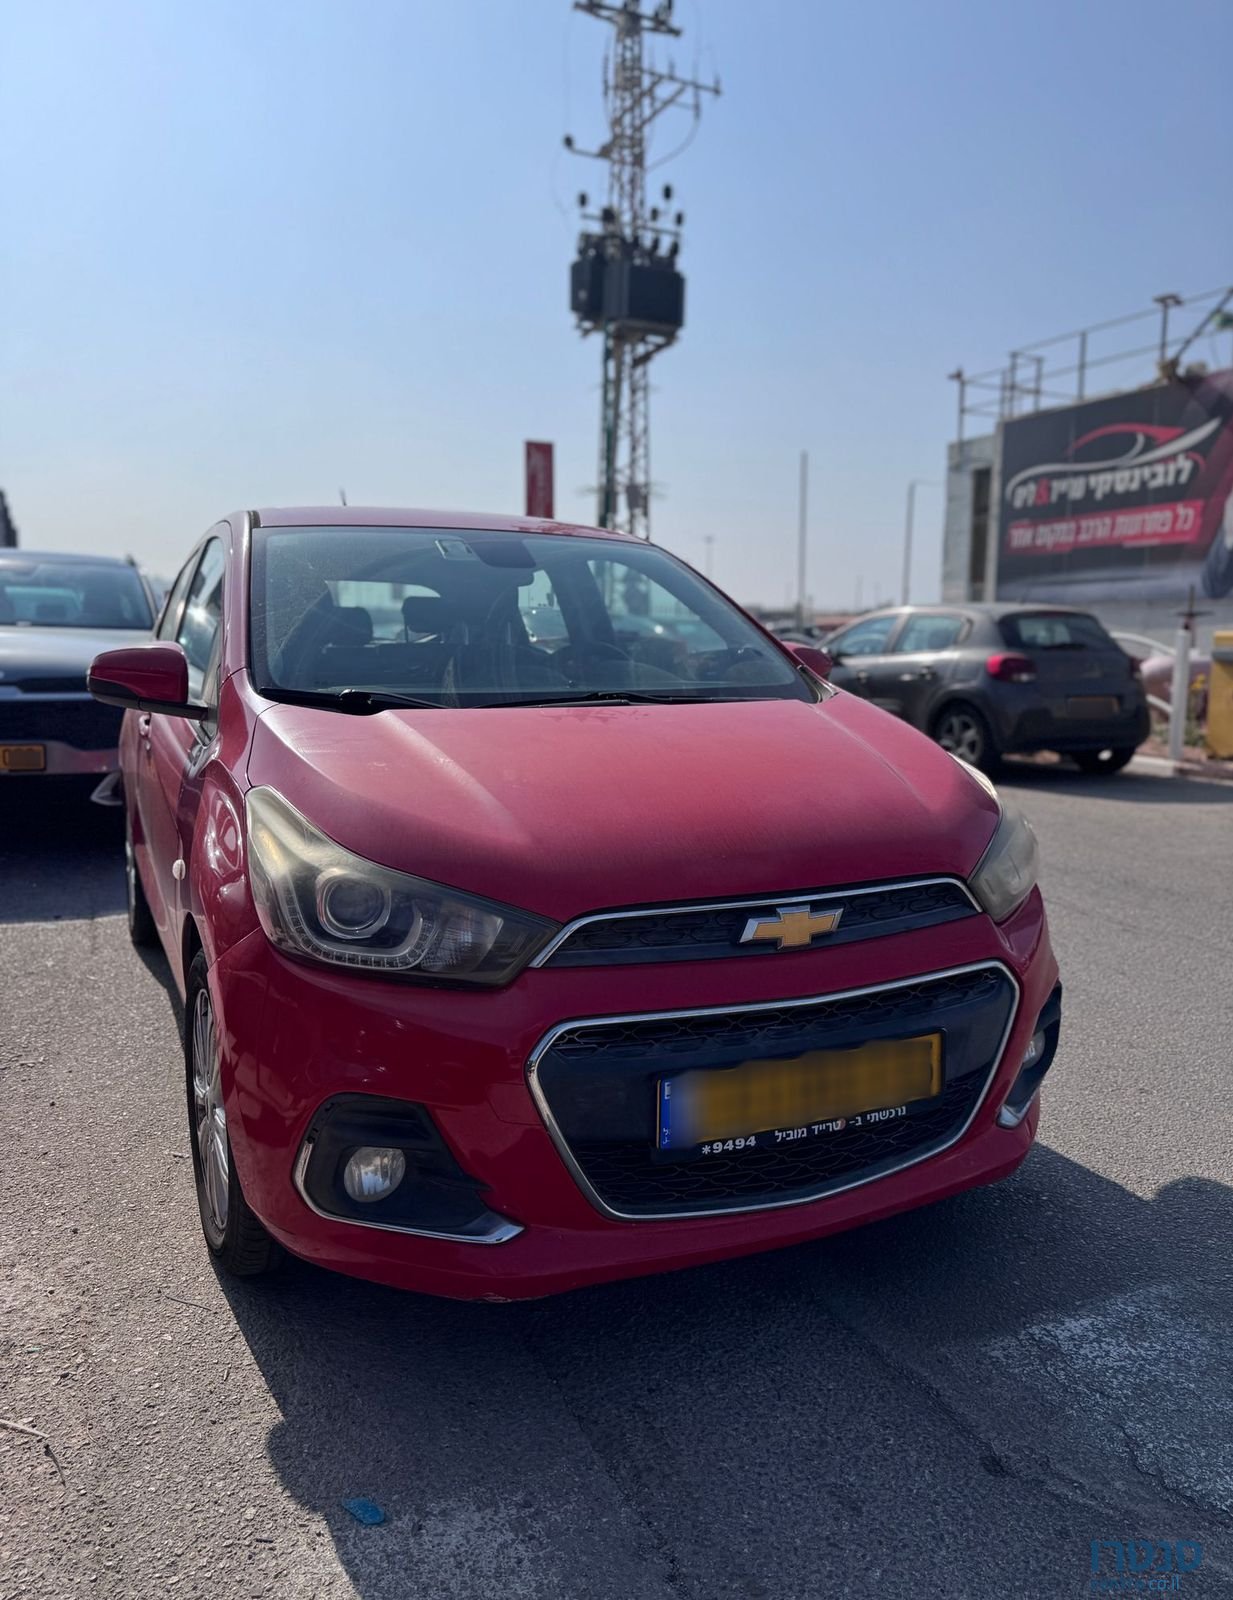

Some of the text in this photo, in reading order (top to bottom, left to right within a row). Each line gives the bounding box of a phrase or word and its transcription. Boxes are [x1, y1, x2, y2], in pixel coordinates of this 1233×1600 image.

[1089, 453, 1193, 498] לובינסקי
[1175, 502, 1195, 530] כל
[867, 1105, 907, 1123] נרכשתי
[774, 1127, 808, 1143] מוביל
[811, 1119, 842, 1135] טרייד
